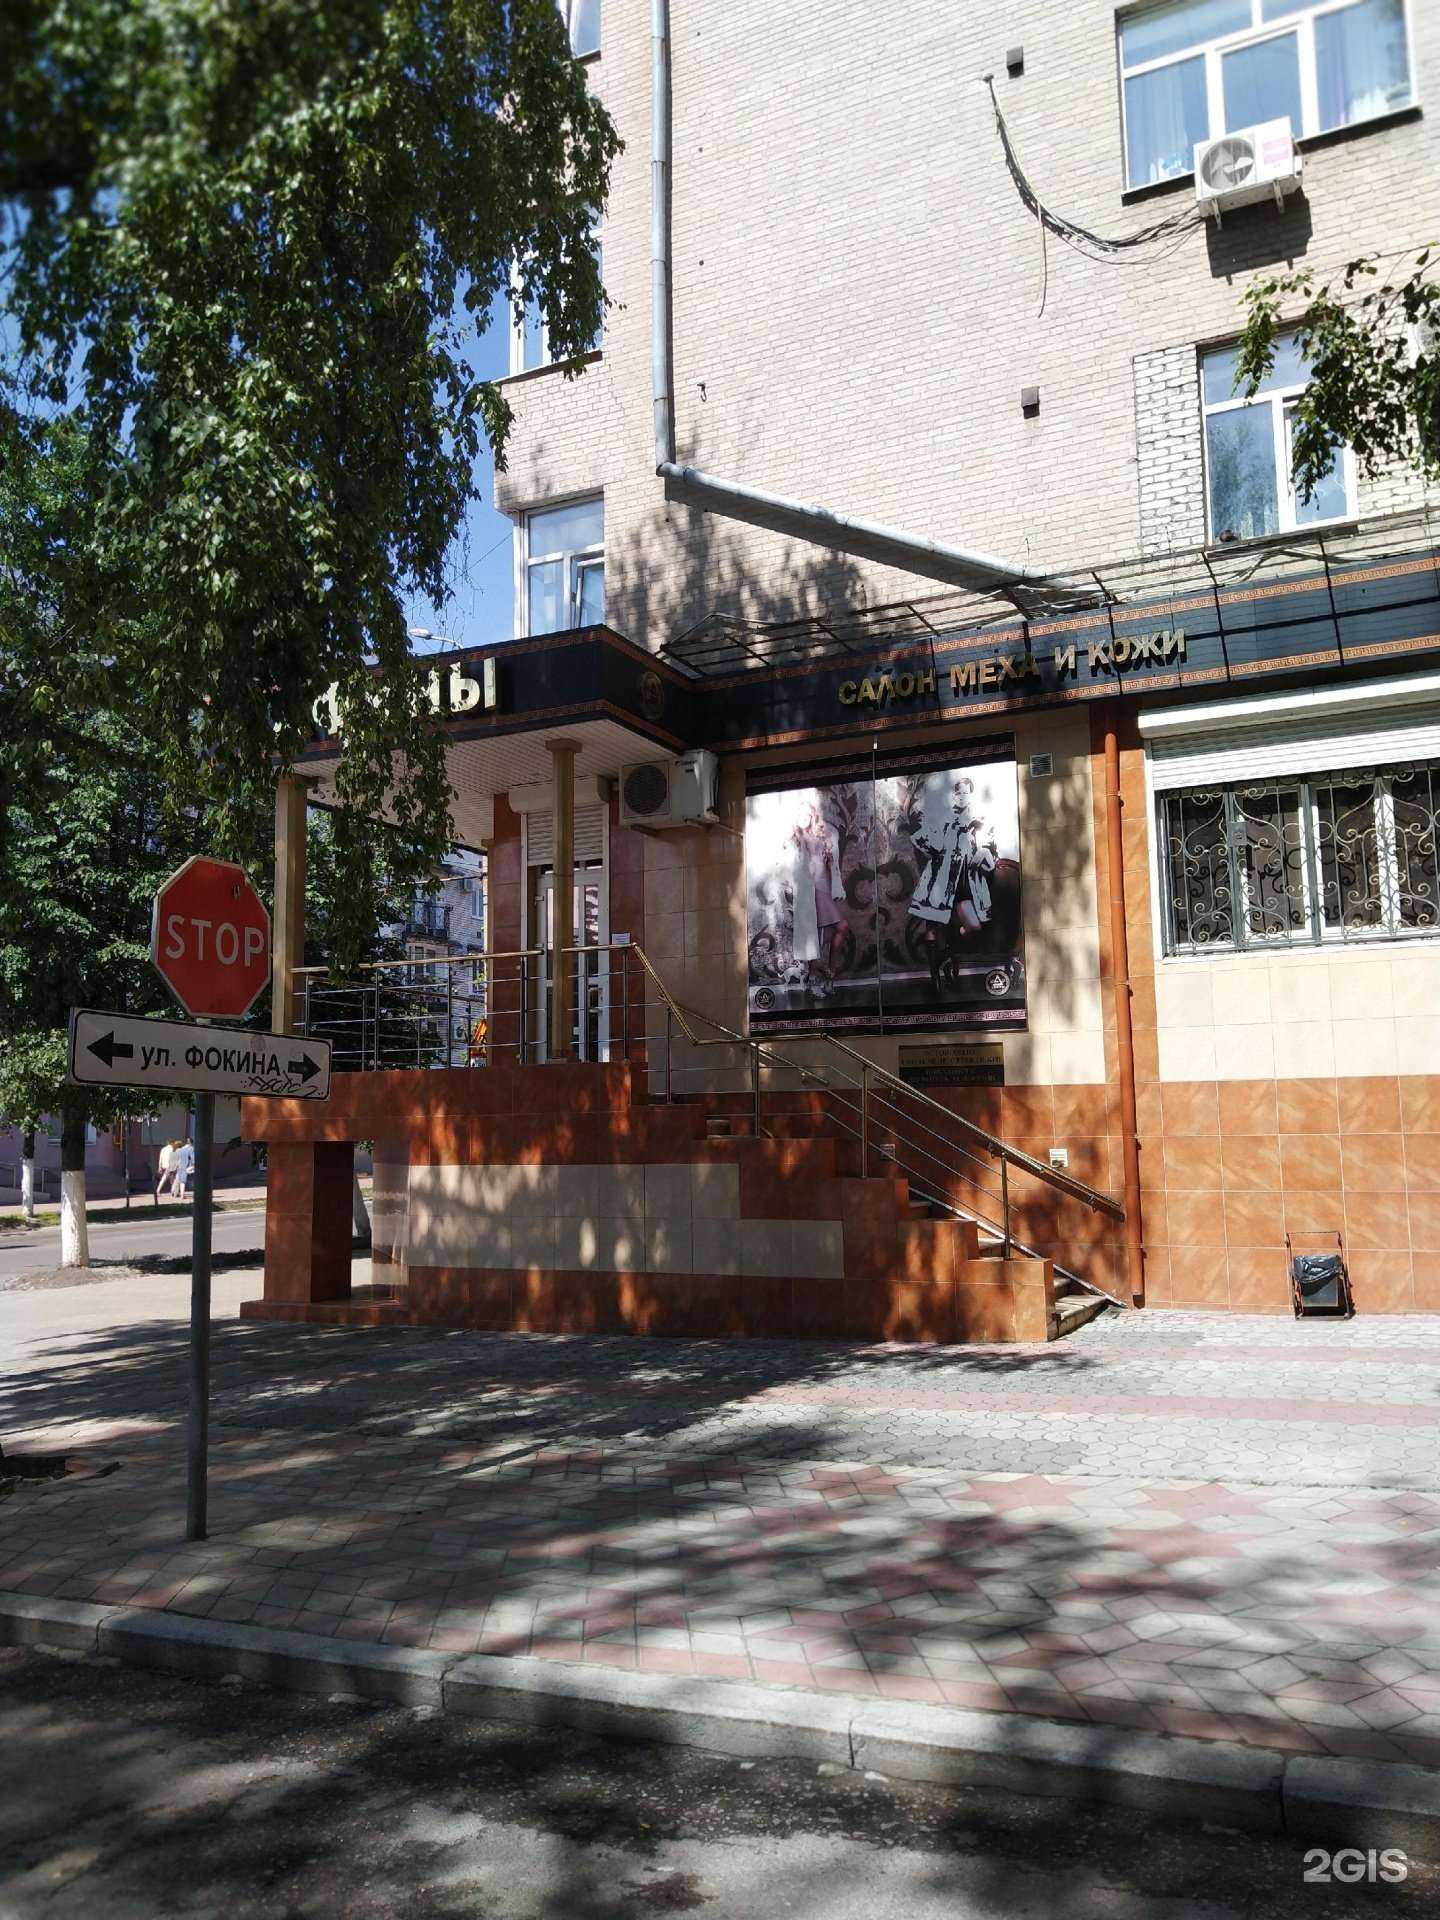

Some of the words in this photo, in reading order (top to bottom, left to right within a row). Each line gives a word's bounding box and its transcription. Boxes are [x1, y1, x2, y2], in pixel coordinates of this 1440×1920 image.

[838, 667, 935, 705] САЛОН
[950, 653, 1039, 688] МЕХА
[1055, 644, 1076, 671] И
[1088, 628, 1186, 667] КОЖИ
[165, 914, 265, 968] STOP
[140, 1044, 176, 1071] ул.
[185, 1046, 281, 1077] ФОКИНА
